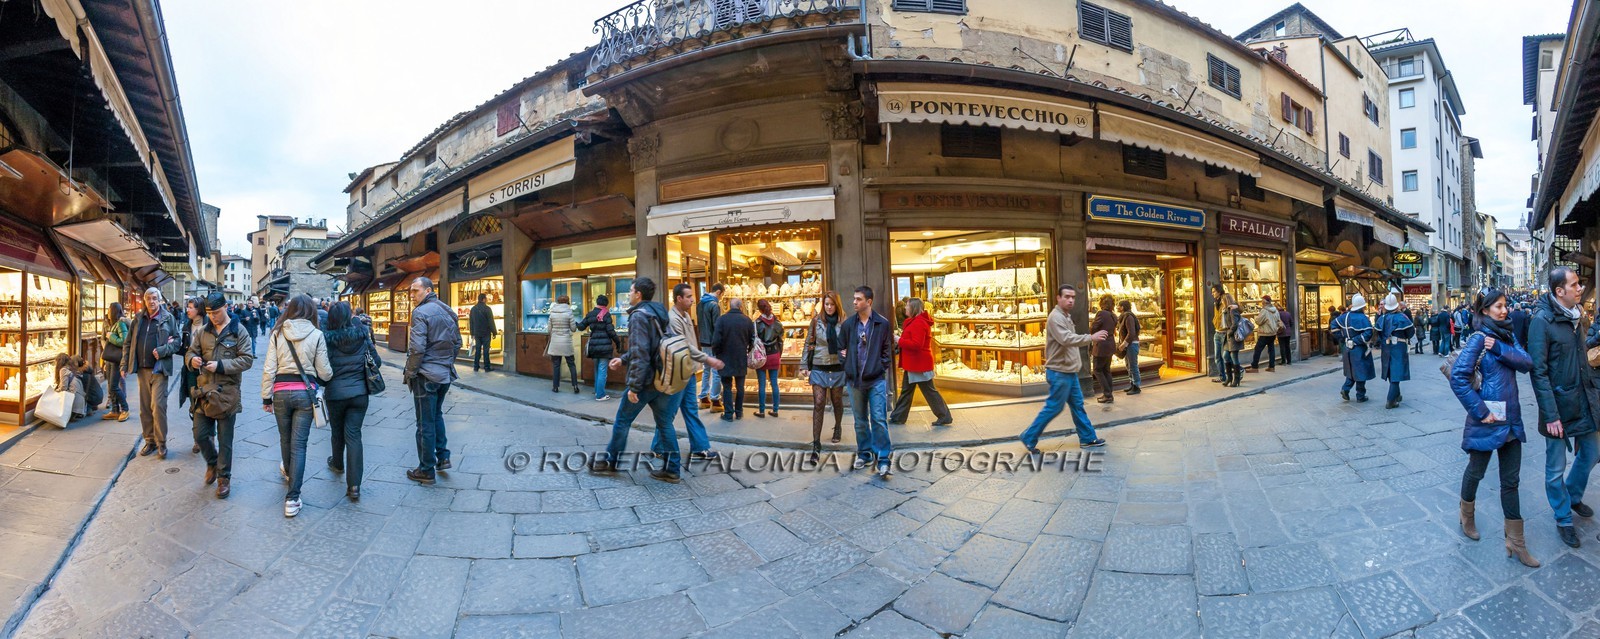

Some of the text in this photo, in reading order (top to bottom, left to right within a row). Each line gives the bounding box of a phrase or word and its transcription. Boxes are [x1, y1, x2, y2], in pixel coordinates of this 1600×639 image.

[910, 100, 1069, 126] PONTEVECCHIO
[1076, 117, 1086, 125] 14
[489, 173, 546, 203] S. TORRISI
[914, 192, 1031, 209] PONTE VECCHIO
[1115, 204, 1188, 222] The Golden River
